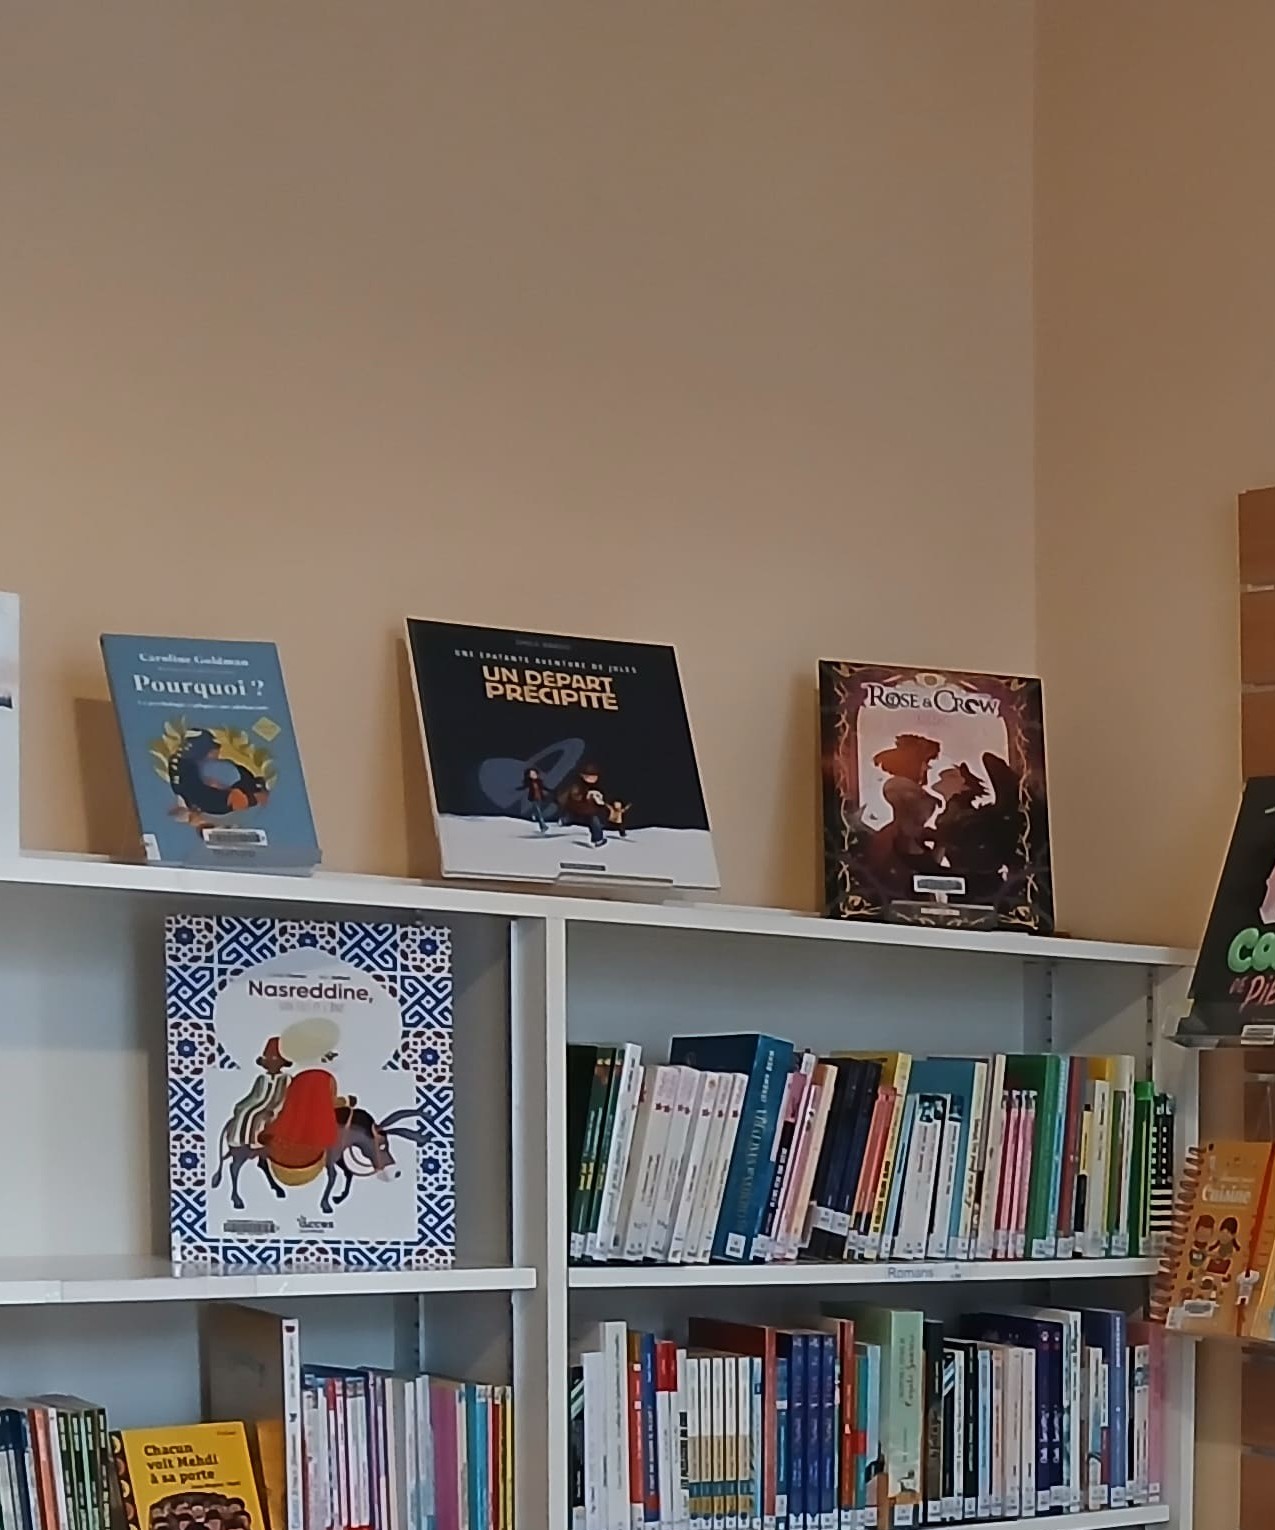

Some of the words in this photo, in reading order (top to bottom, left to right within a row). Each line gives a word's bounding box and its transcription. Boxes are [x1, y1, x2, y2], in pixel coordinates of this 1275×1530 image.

[482, 665, 519, 684] UN
[133, 674, 246, 699] Pourquoi
[251, 680, 265, 697] ?
[868, 683, 919, 709] ROSE
[934, 689, 998, 714] CROW
[248, 980, 374, 1004] Nasreddine,
[888, 1267, 934, 1279] Romans
[143, 1442, 194, 1457] Chacun
[147, 1456, 175, 1470] voit
[178, 1453, 219, 1469] Mehdi
[161, 1472, 177, 1484] sa
[180, 1470, 215, 1486] porte
